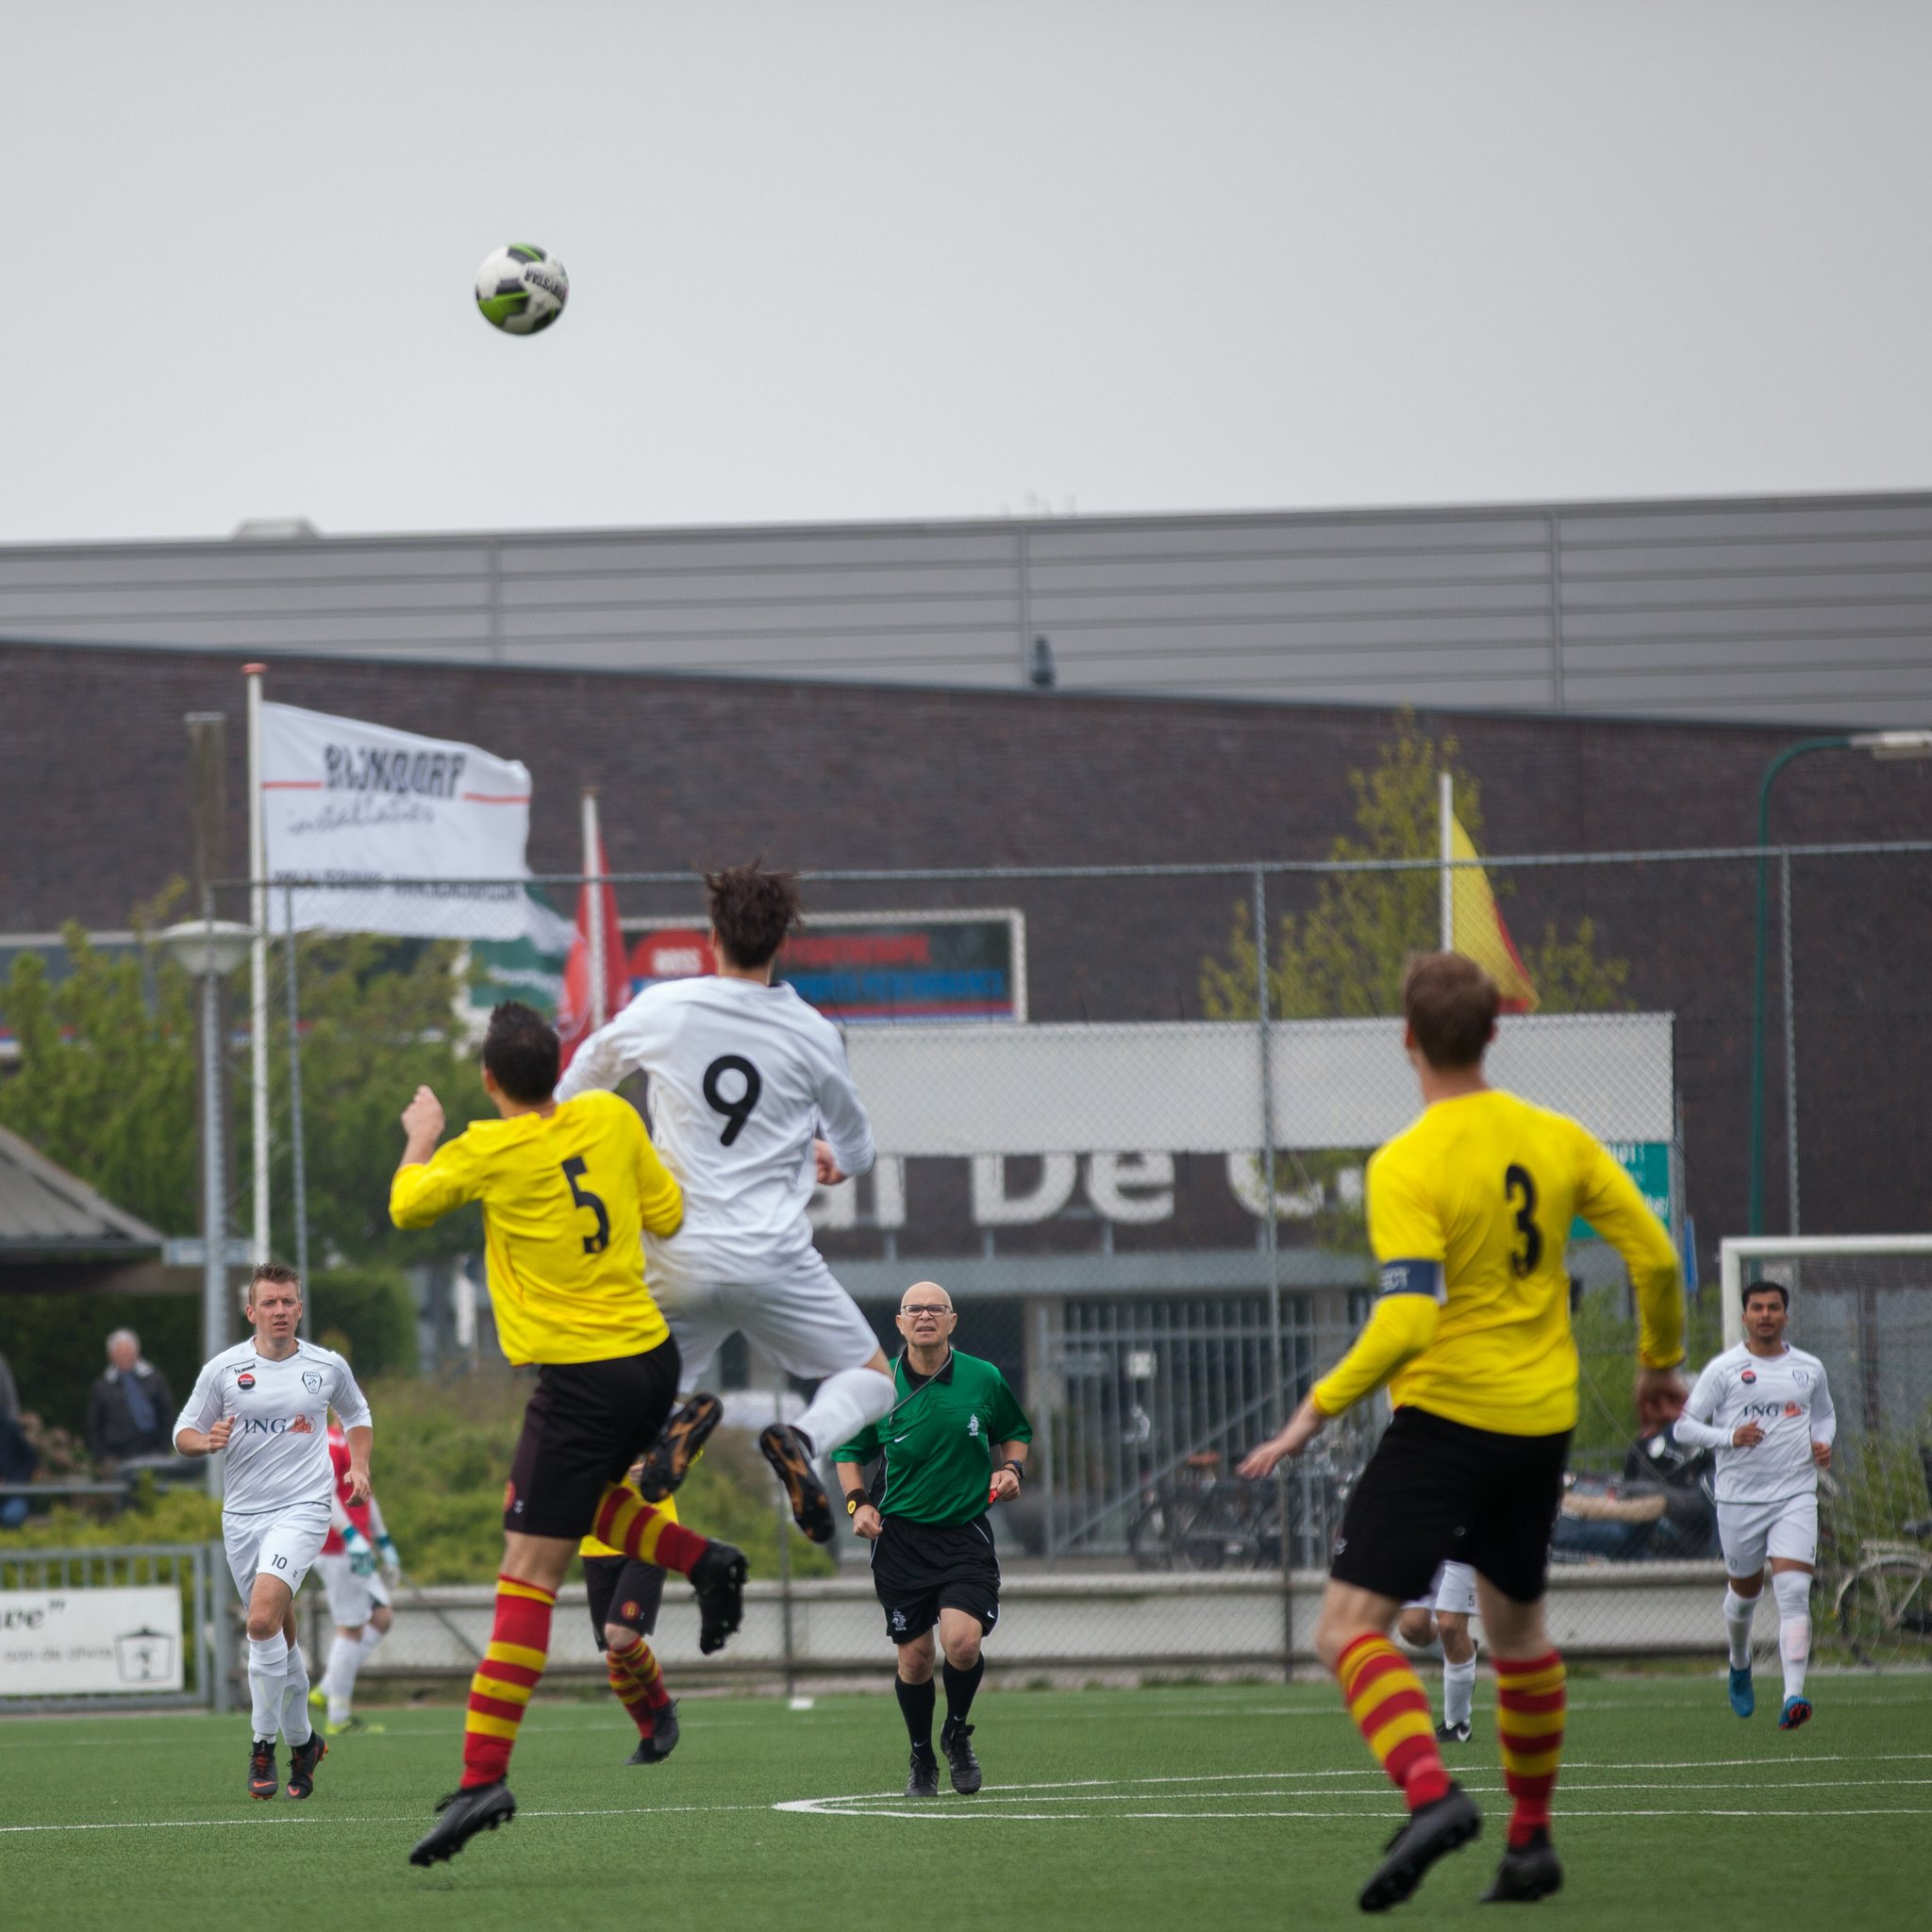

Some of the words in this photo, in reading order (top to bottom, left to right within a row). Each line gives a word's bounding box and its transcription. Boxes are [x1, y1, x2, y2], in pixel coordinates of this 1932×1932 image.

[703, 1054, 760, 1147] 9
[560, 1156, 609, 1255] 5
[972, 1151, 1175, 1225] De
[1505, 1163, 1544, 1279] 3
[243, 1417, 287, 1434] ING
[1742, 1405, 1779, 1417] ING
[271, 1554, 288, 1570] 10
[1468, 1593, 1475, 1607] 5
